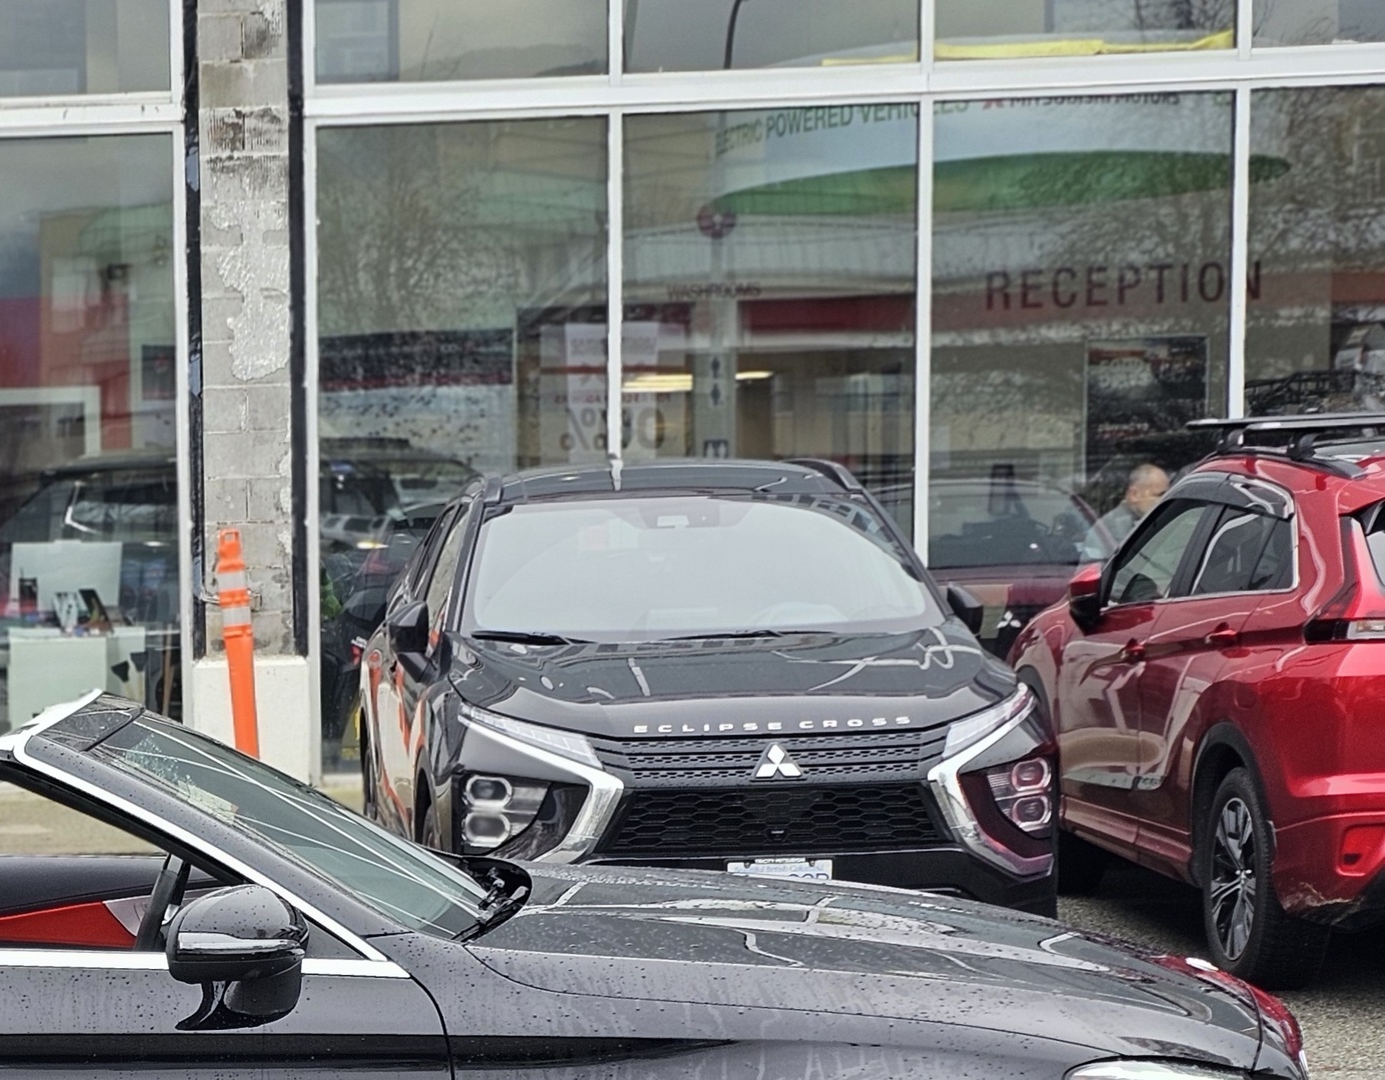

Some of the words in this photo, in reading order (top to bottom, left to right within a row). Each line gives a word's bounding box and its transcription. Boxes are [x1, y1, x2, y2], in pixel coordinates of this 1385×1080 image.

[766, 104, 854, 139] POWERED
[986, 260, 1262, 311] RECEPTION
[633, 722, 782, 734] ECLIPSE
[799, 716, 911, 729] CROSS
